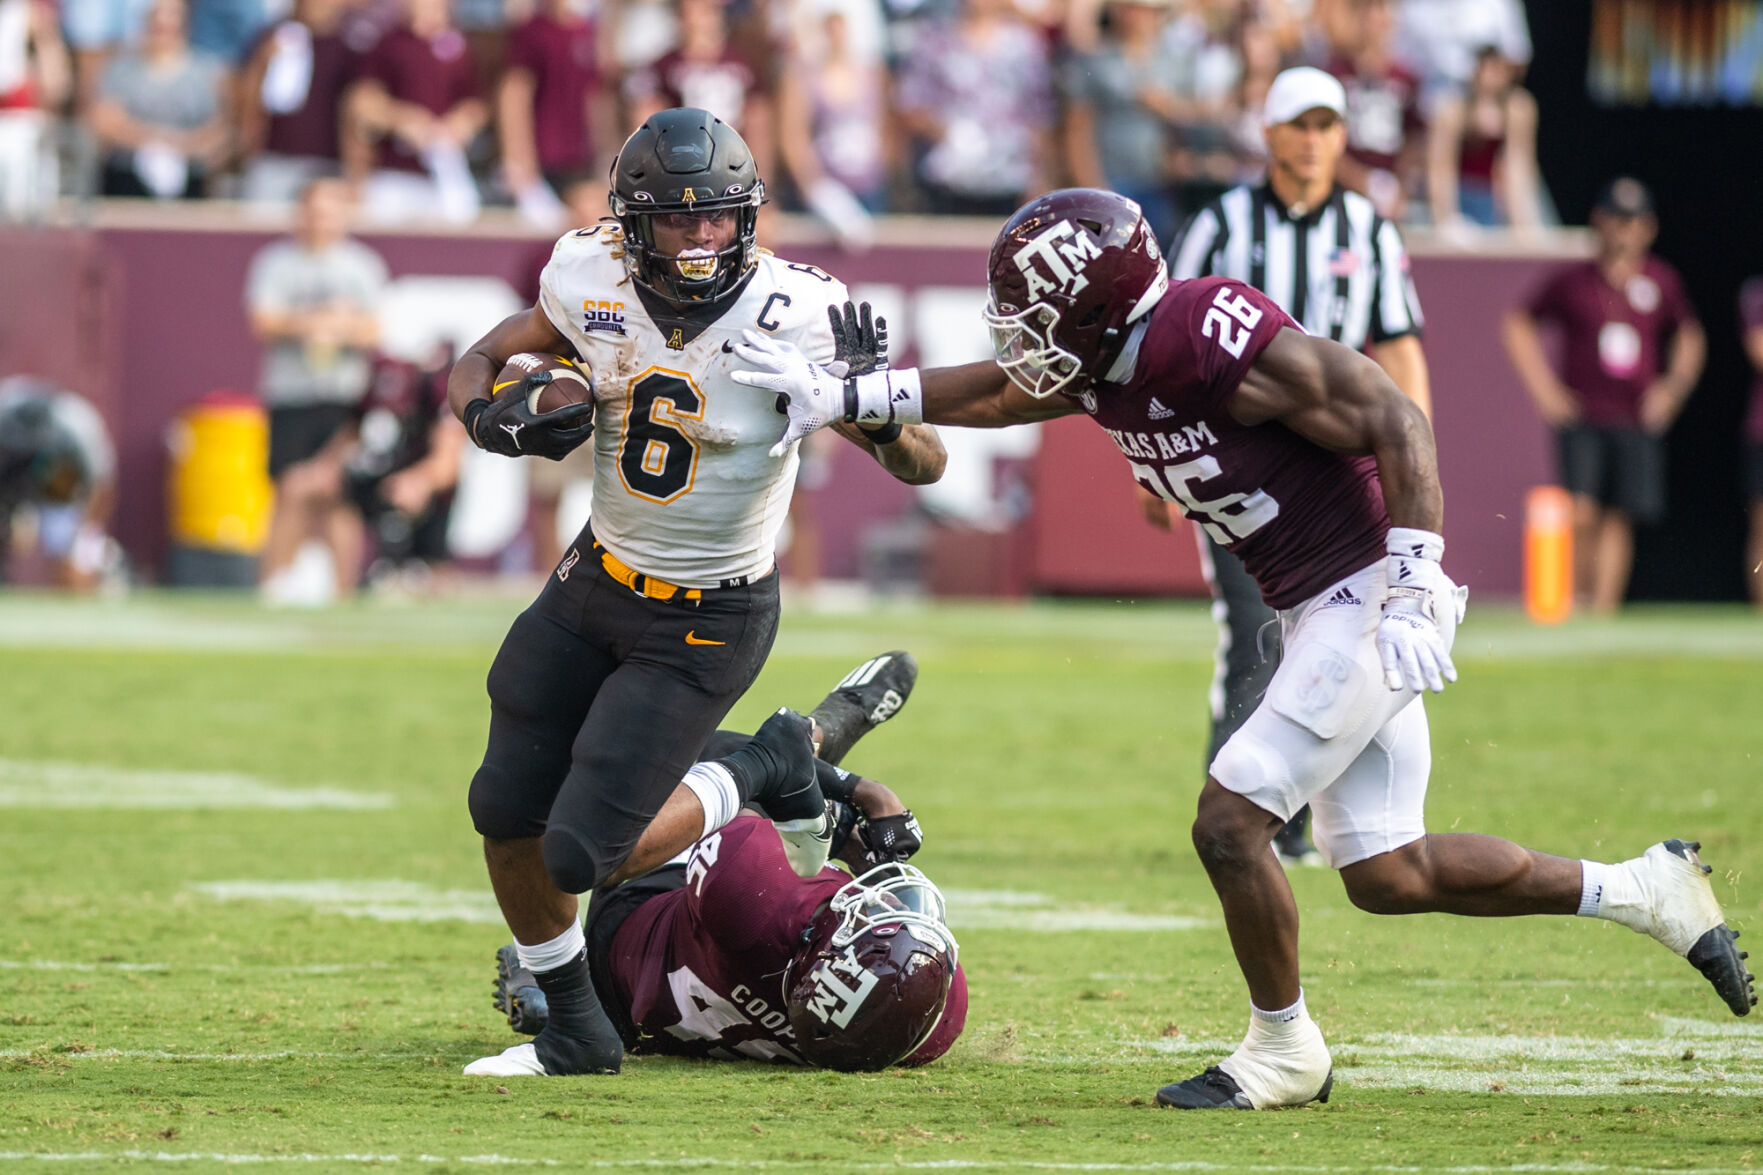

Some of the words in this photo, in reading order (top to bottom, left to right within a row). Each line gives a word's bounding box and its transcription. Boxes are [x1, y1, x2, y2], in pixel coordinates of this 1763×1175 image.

[583, 300, 625, 323] SBC
[756, 291, 792, 333] C
[1201, 286, 1263, 360] 26
[616, 365, 706, 506] 6
[1153, 420, 1219, 461] A&M
[729, 578, 740, 588] M
